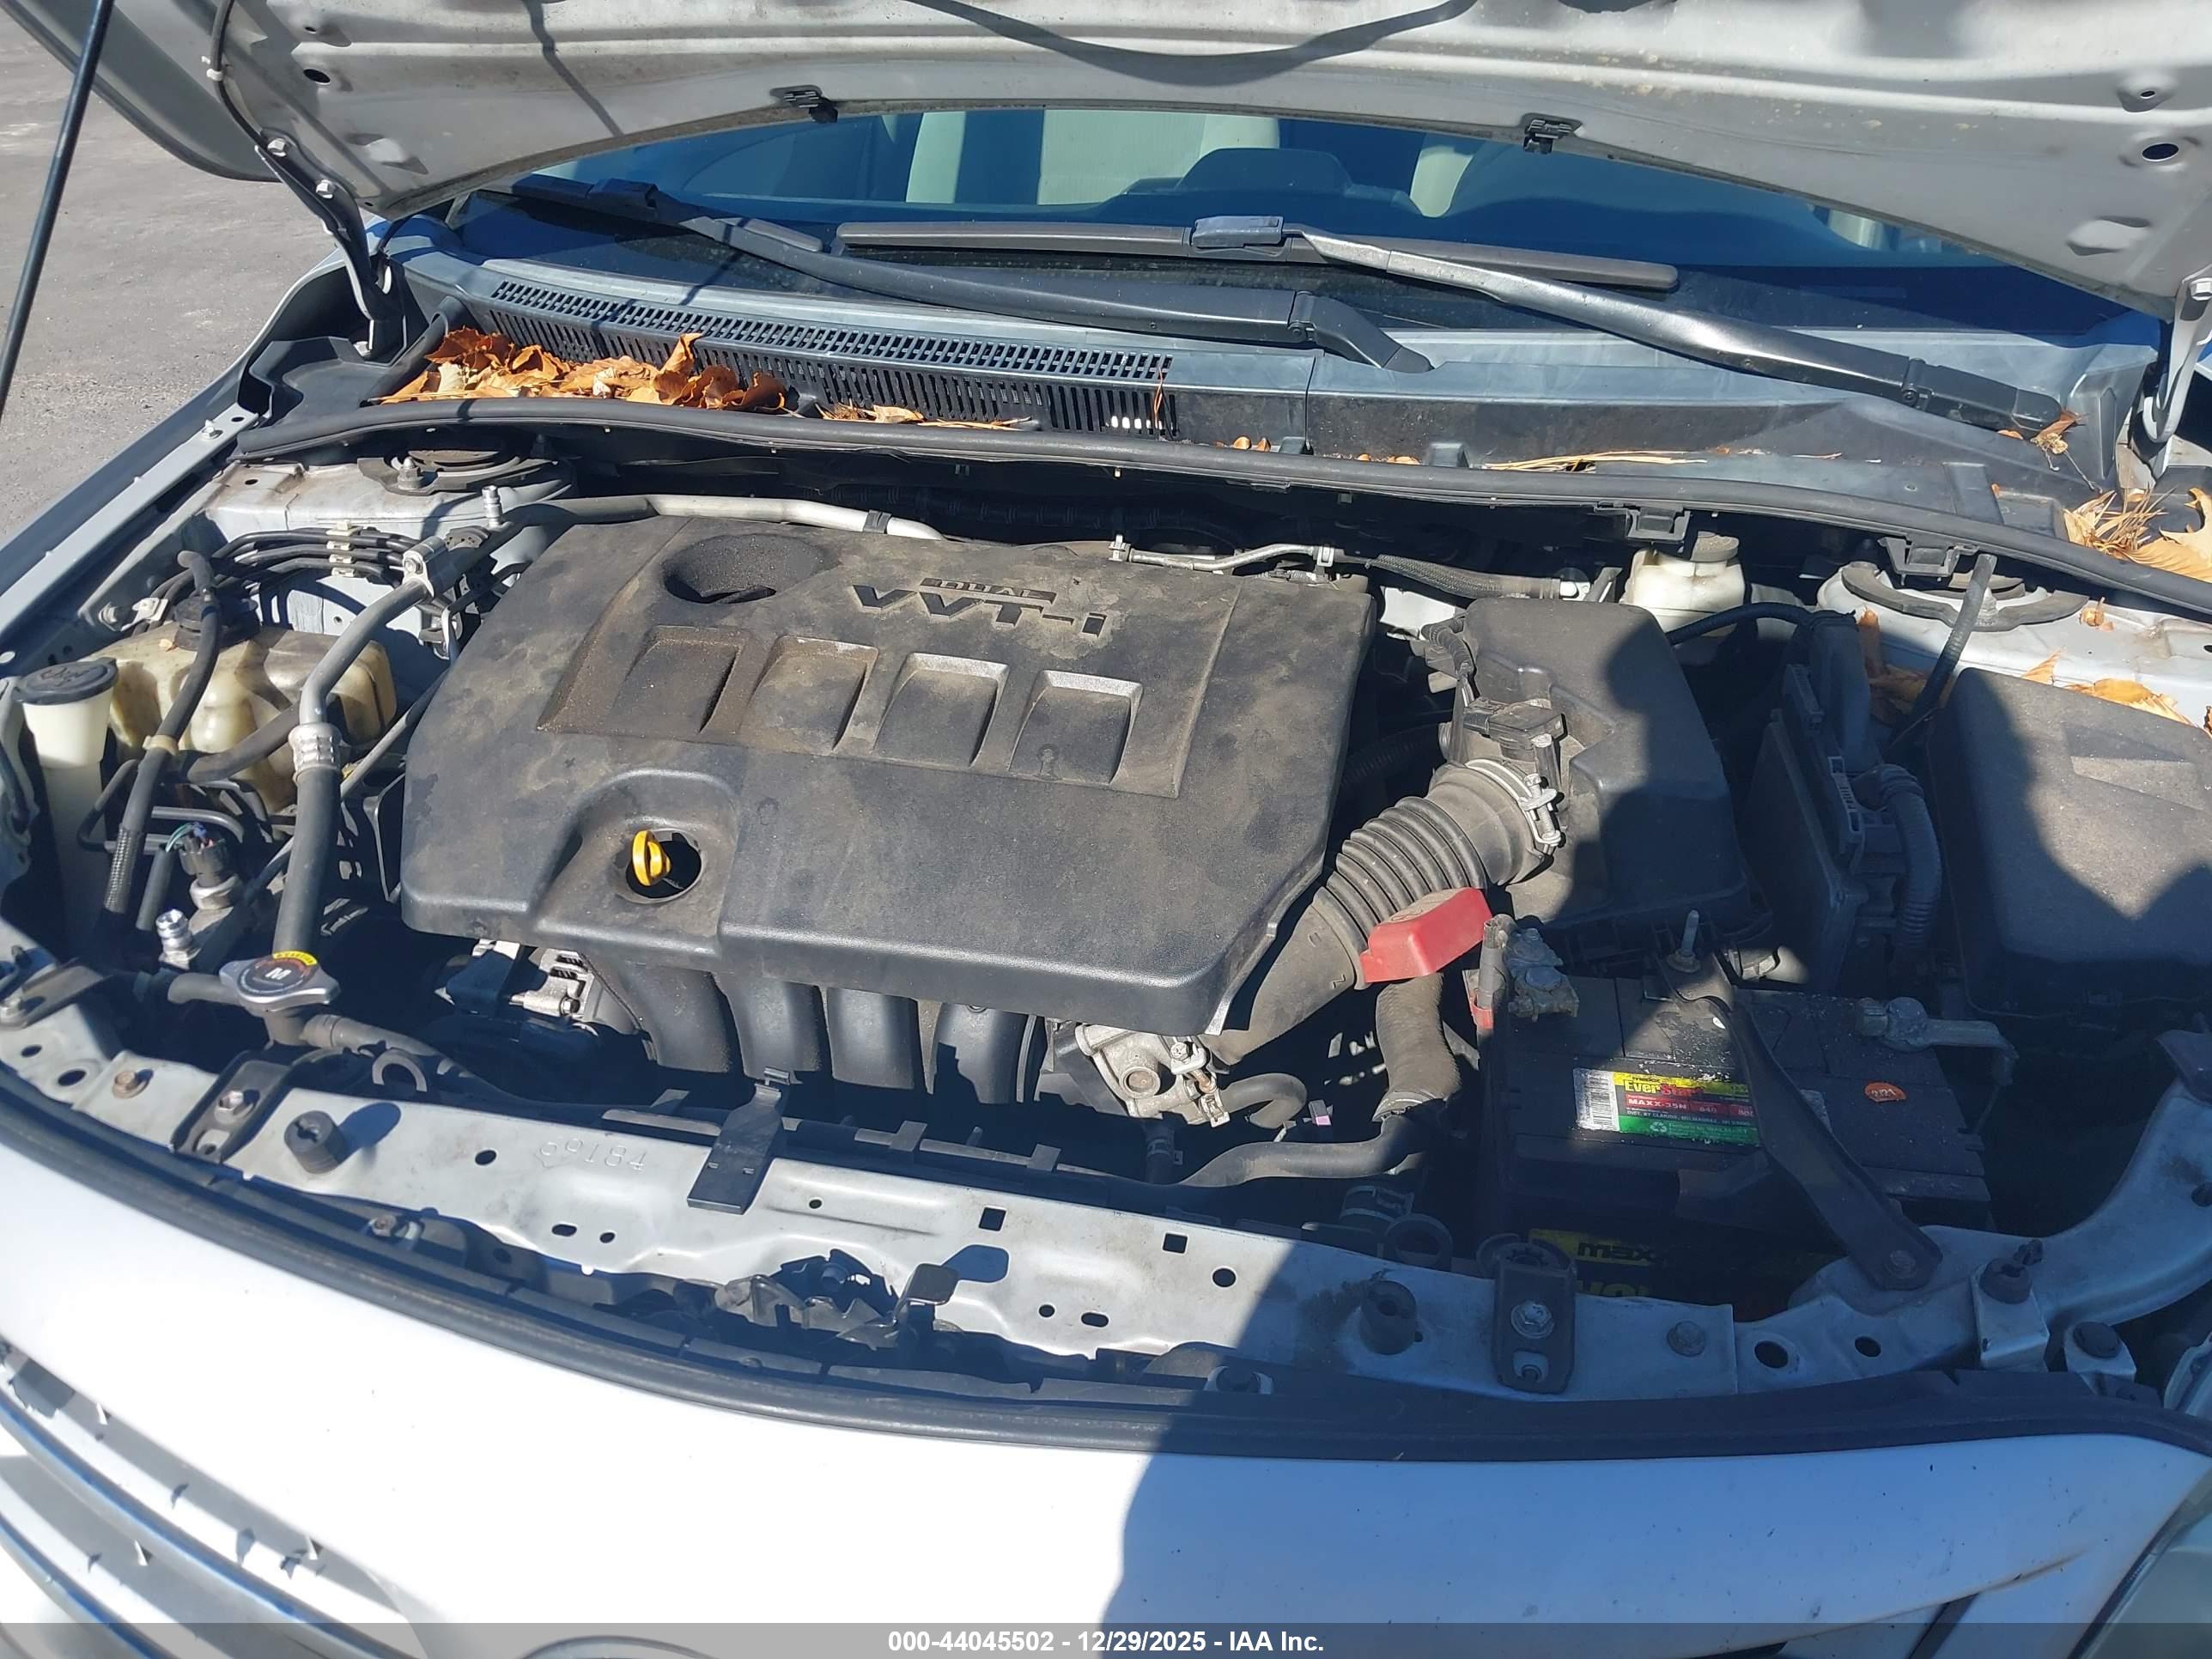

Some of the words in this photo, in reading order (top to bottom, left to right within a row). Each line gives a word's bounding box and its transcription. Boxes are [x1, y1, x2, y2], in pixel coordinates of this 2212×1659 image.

[939, 580, 1044, 599] DUAL
[853, 584, 1108, 638] VVT-i
[1624, 1079, 1704, 1097] EverStart
